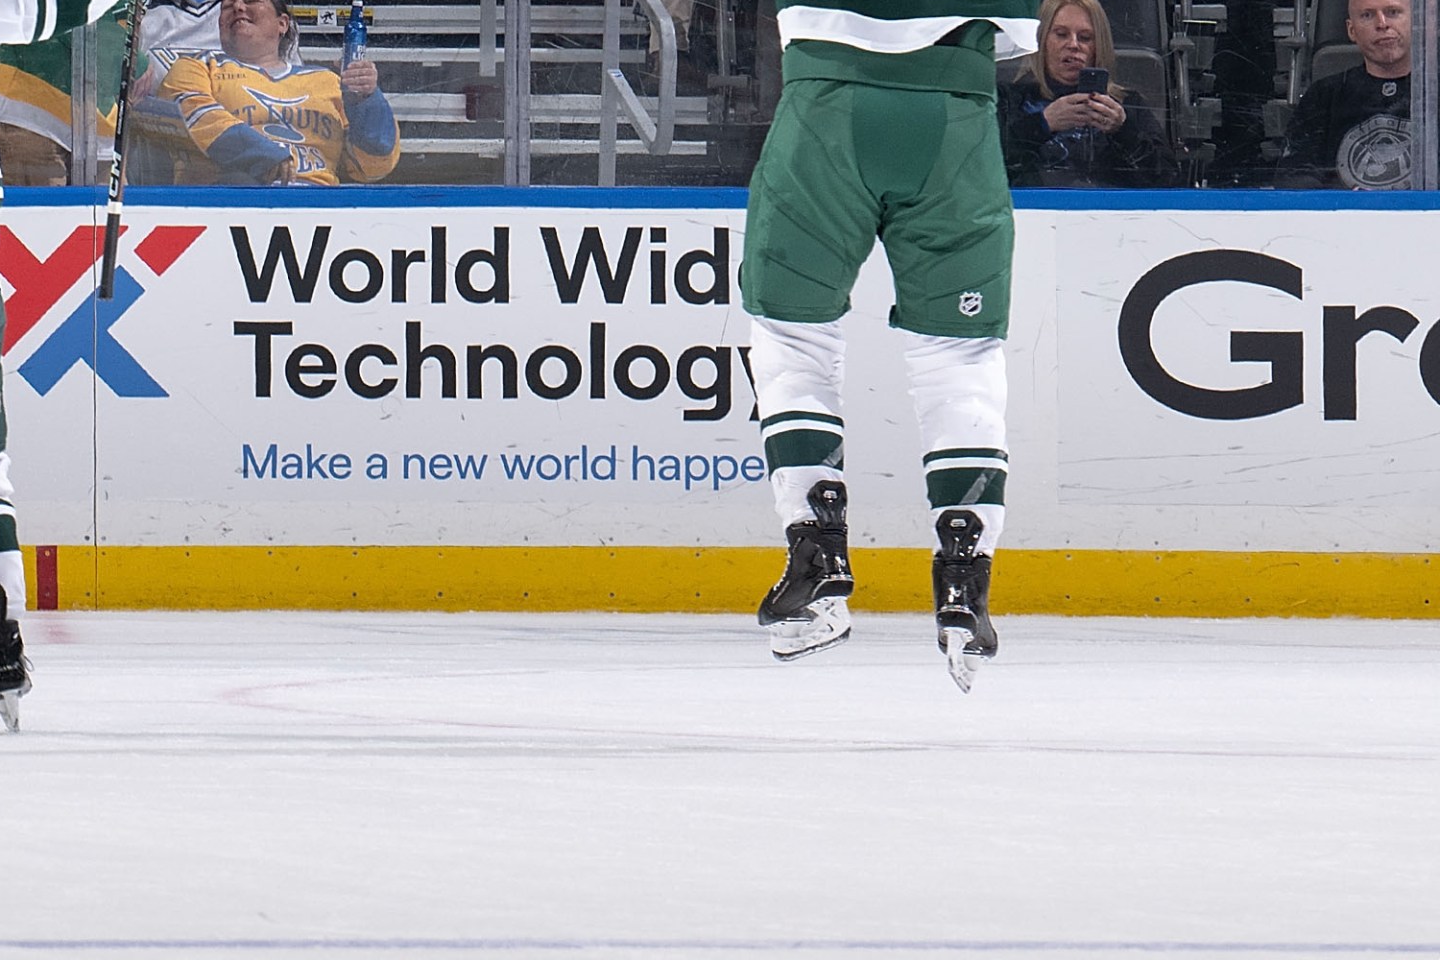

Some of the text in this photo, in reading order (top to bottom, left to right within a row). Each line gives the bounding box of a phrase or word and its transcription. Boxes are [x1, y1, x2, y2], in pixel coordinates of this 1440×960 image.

[229, 225, 746, 306] World Wid
[241, 444, 766, 491] Make a new world happe
